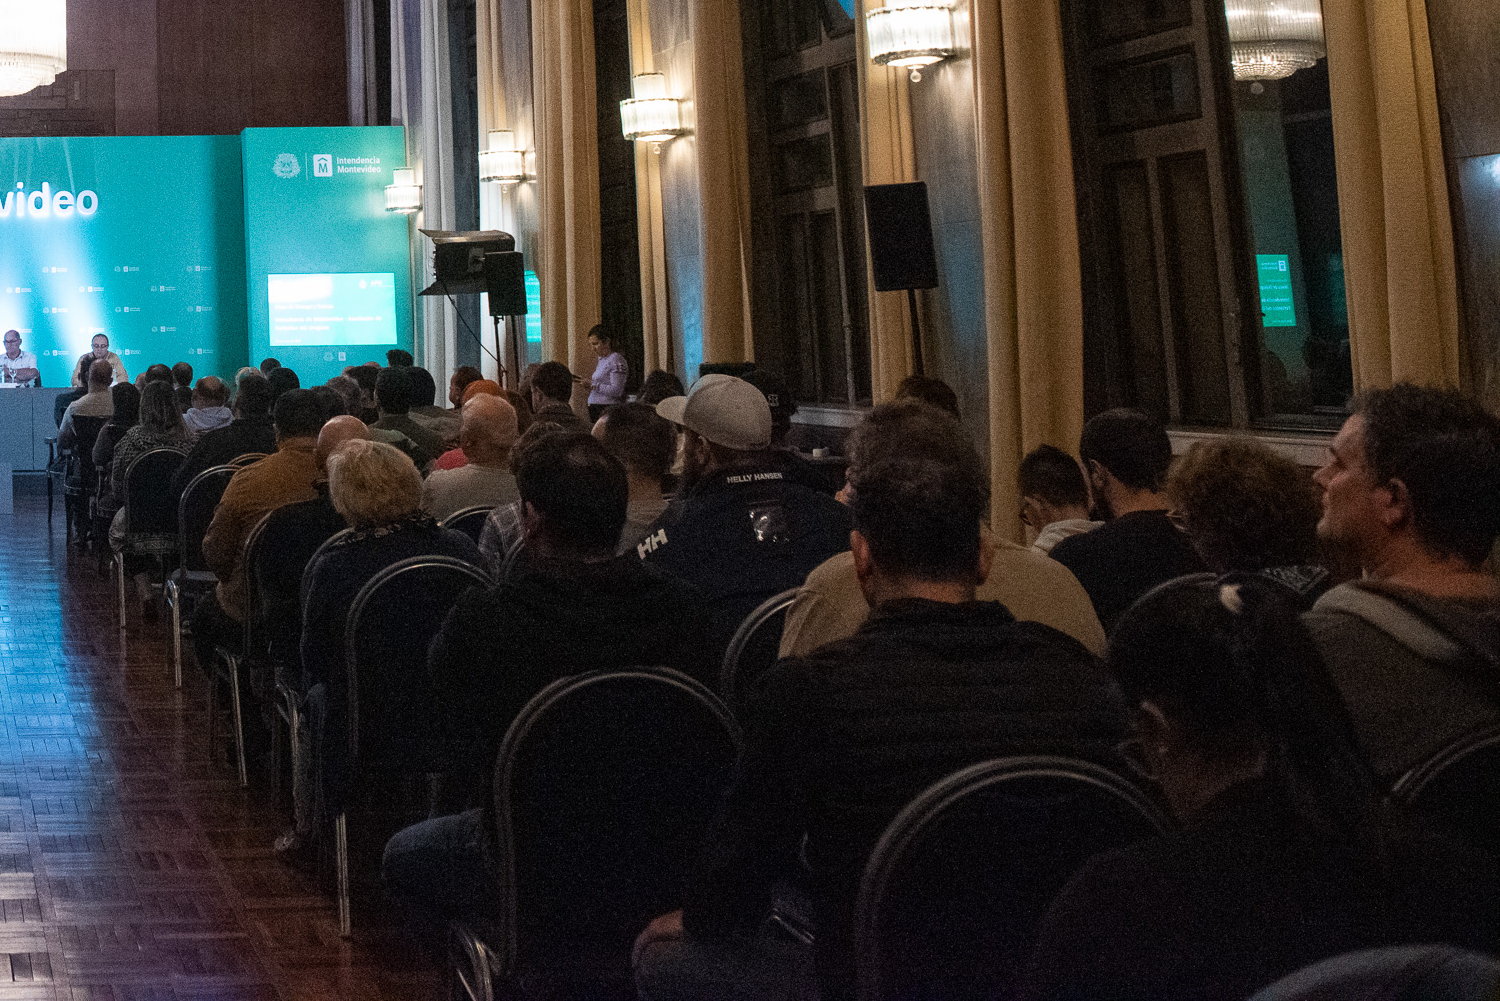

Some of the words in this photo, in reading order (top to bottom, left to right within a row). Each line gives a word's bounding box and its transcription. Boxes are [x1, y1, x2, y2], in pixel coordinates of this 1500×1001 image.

[336, 156, 380, 164] Intendencia
[337, 164, 381, 173] Montevideo
[727, 474, 752, 484] HELLY
[754, 472, 783, 481] HANSEN
[636, 528, 669, 561] HH
